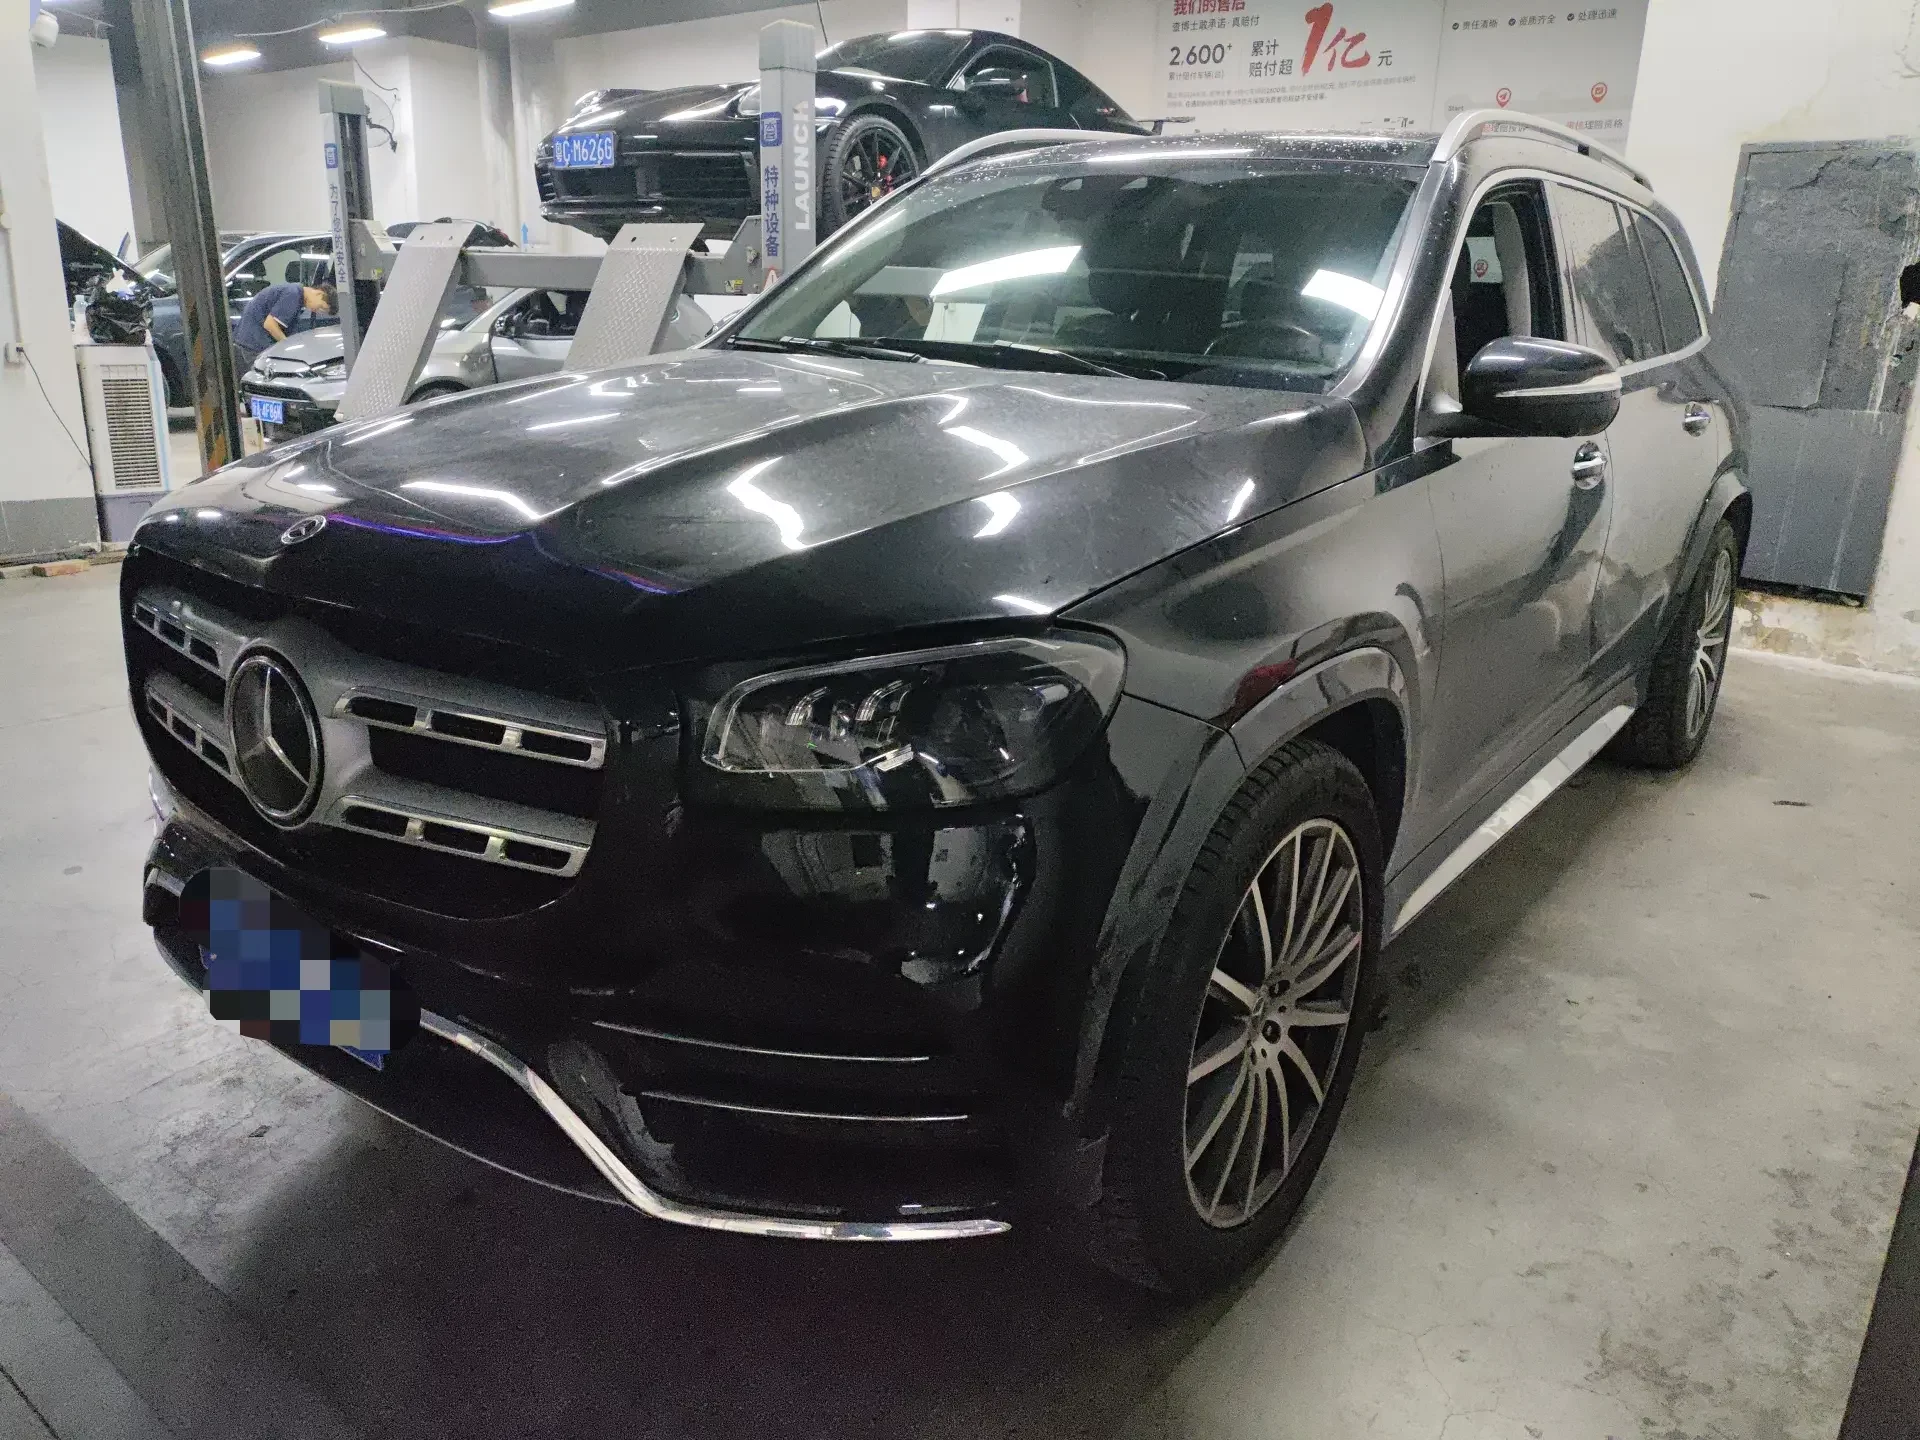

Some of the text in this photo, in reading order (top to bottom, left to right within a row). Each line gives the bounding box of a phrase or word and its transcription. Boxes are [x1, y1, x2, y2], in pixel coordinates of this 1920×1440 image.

[1251, 39, 1279, 56] 累计
[1249, 59, 1293, 78] 赔付超
[1377, 50, 1393, 67] 元
[1448, 104, 1464, 112] Start
[764, 164, 780, 257] 特种设备
[329, 183, 347, 283] 为了您的安全
